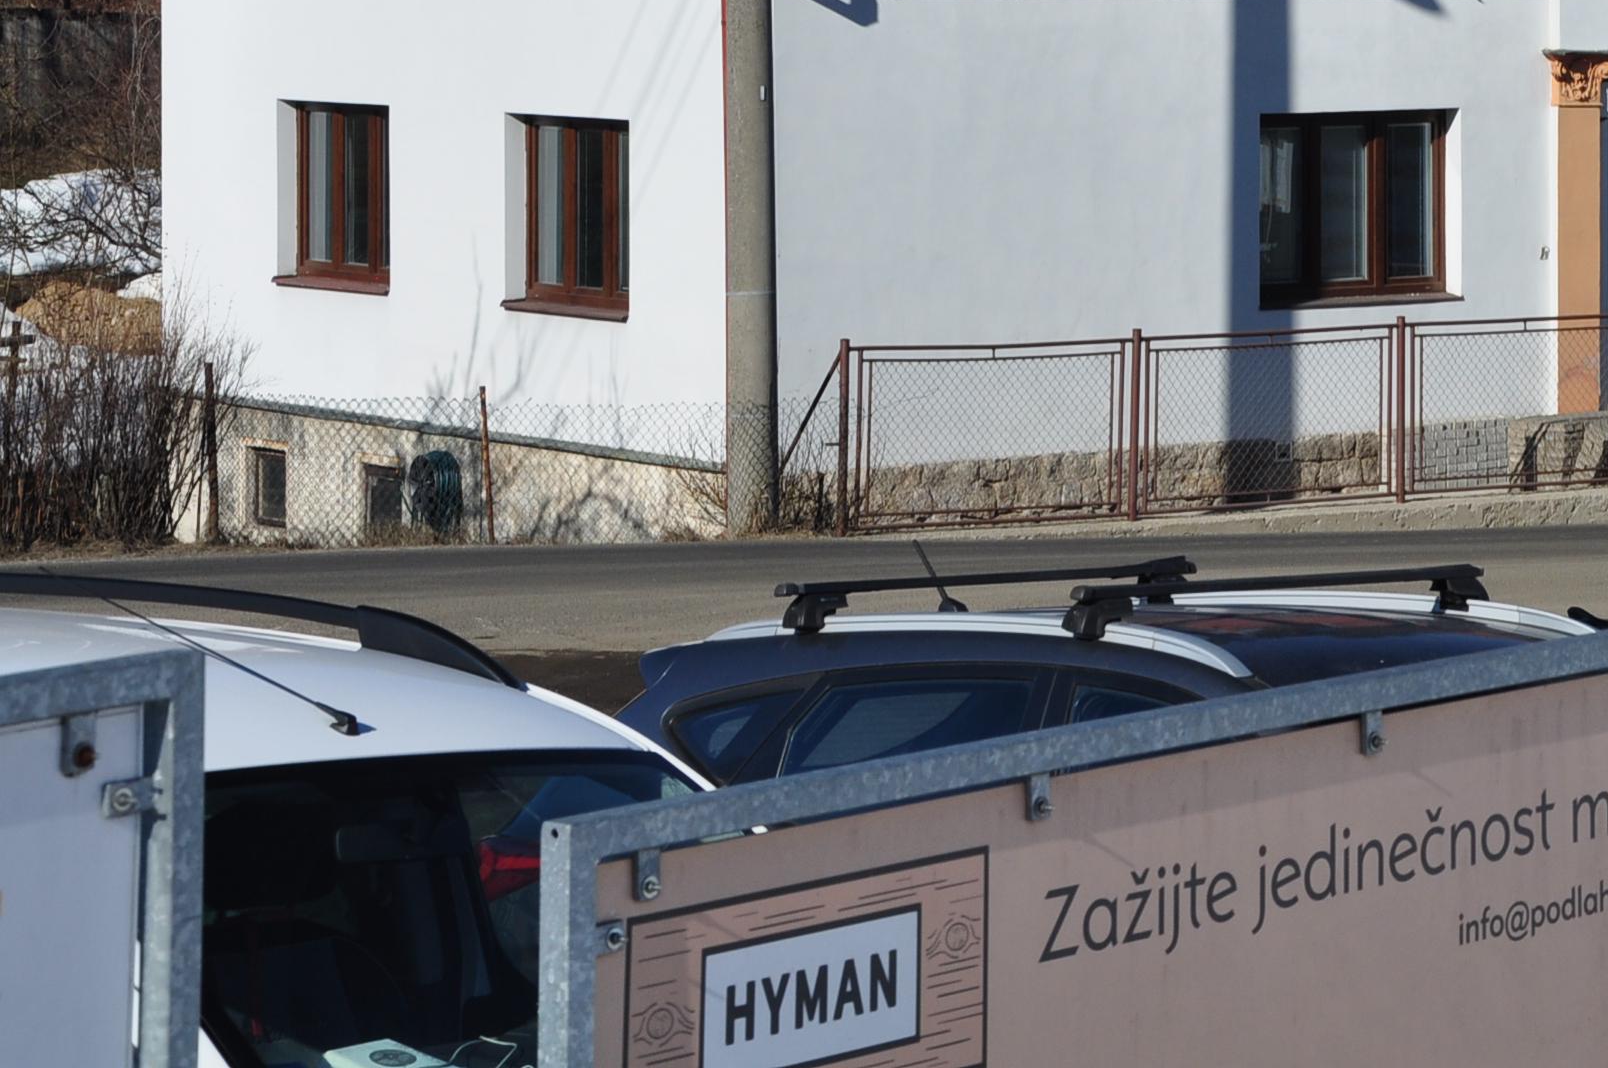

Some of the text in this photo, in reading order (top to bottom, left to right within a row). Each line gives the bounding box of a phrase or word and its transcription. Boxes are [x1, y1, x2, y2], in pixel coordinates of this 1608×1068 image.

[1039, 861, 1238, 964] Zažijte
[1252, 788, 1557, 935] jedinečnost
[725, 949, 898, 1047] HYMAN
